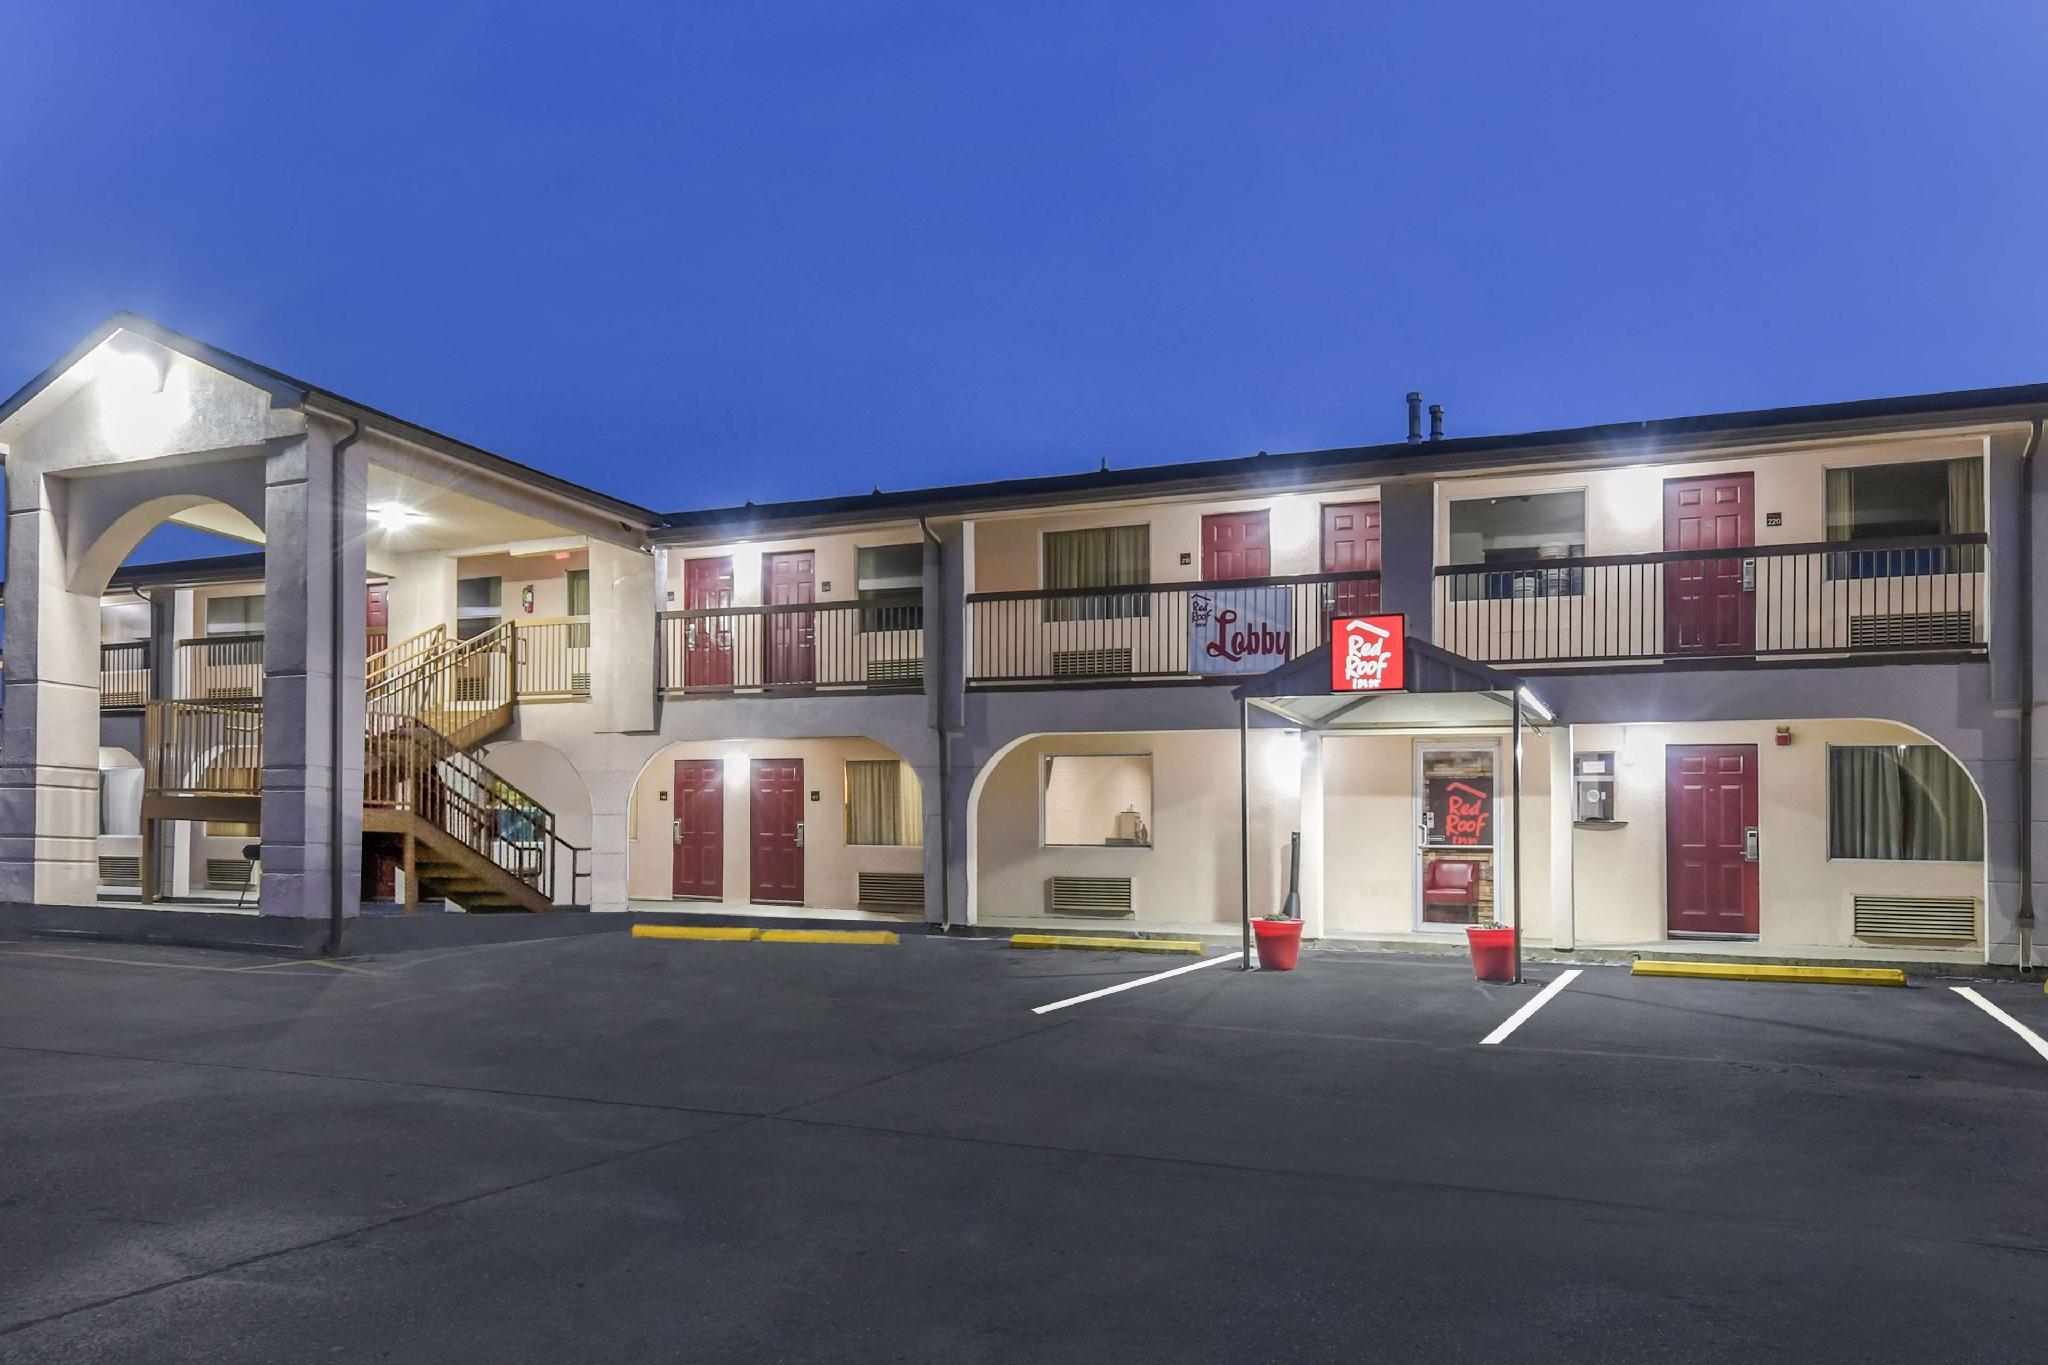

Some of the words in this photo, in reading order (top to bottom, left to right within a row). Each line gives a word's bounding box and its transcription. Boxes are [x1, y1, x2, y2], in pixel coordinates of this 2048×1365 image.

[1767, 518, 1781, 526] 220
[1192, 609, 1212, 623] Roof
[1193, 601, 1208, 612] Red
[1207, 610, 1290, 662] Lobby
[1348, 635, 1383, 657] Red
[1345, 652, 1391, 680] Roof
[1353, 678, 1381, 689] Inn
[1449, 796, 1481, 816] Red
[1446, 812, 1489, 836] Roof
